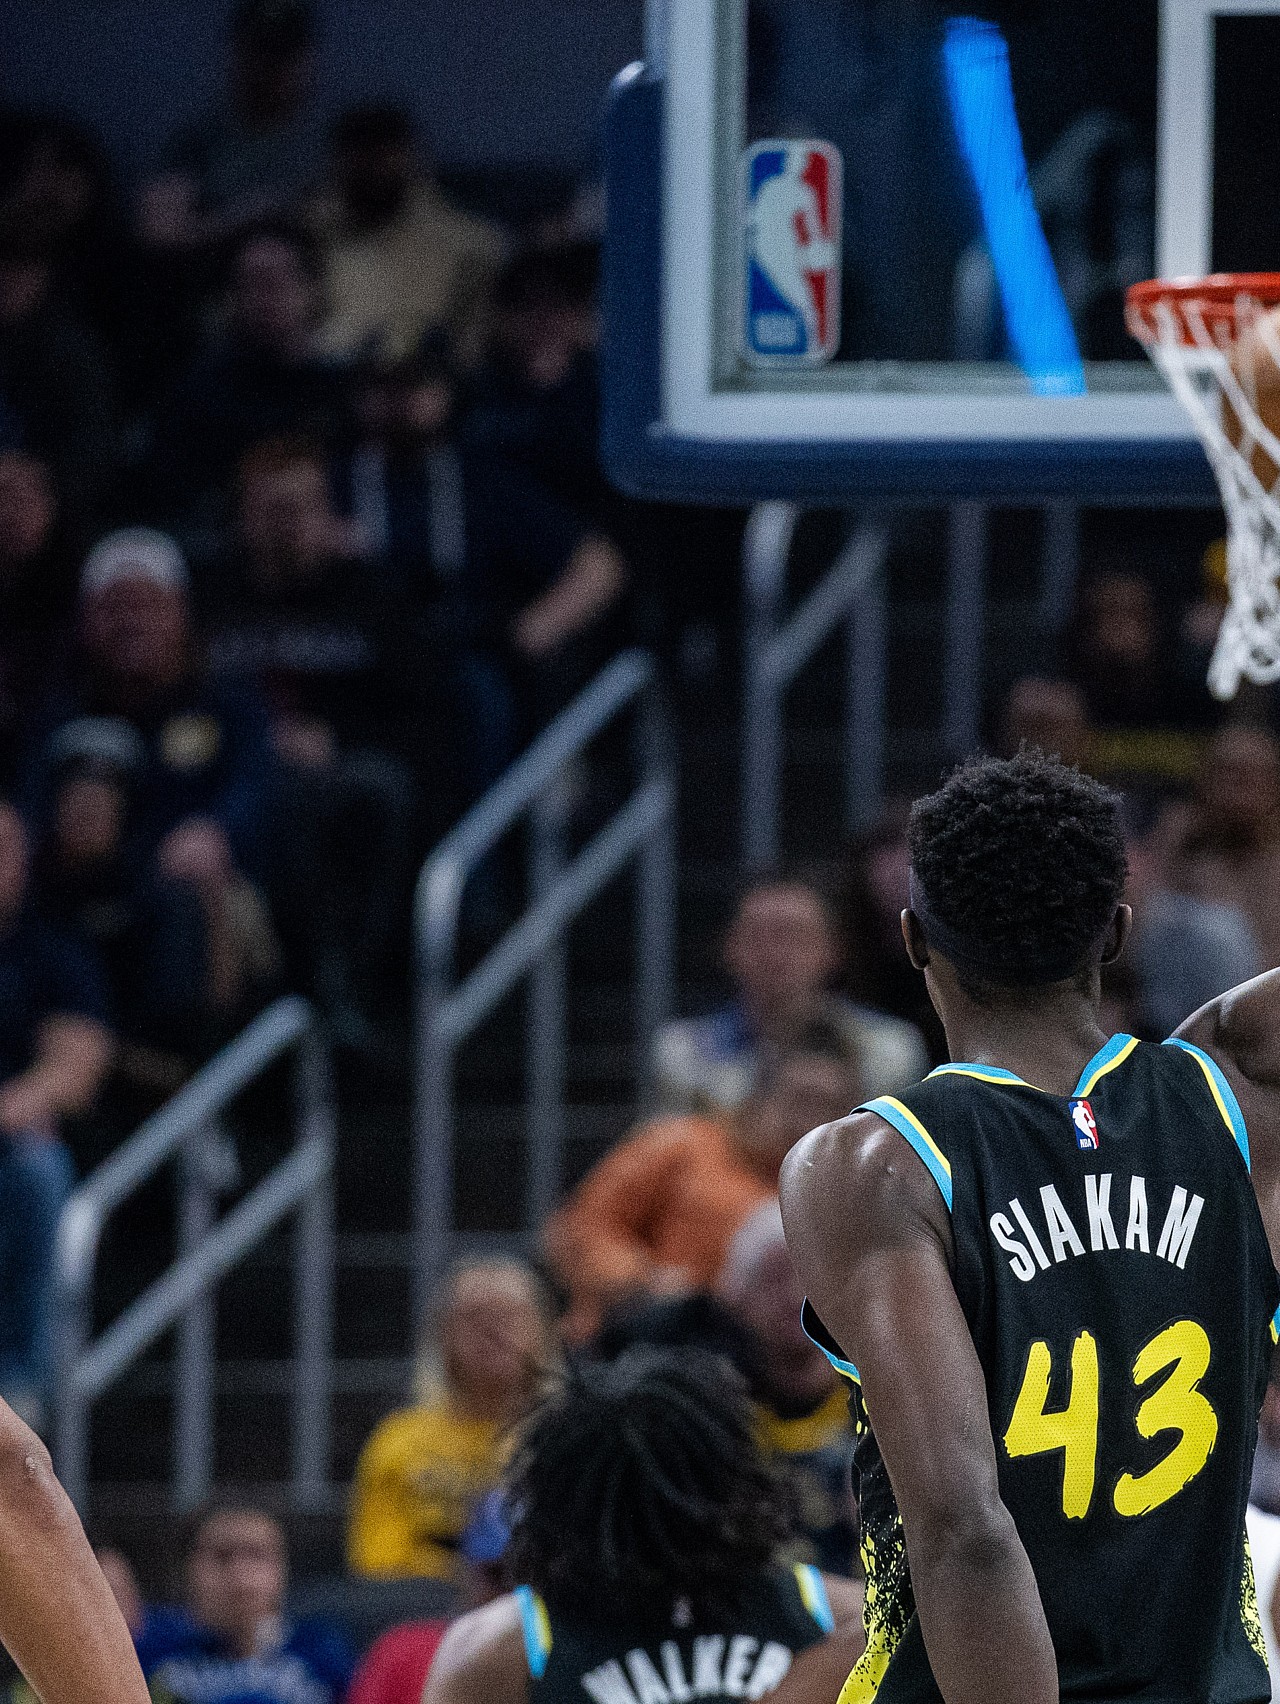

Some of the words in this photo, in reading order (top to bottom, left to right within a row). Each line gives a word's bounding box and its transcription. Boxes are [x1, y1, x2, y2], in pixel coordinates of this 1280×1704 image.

[1079, 1138, 1092, 1148] NBA
[990, 1173, 1205, 1282] SIAKAM
[1003, 1319, 1219, 1519] 43
[580, 1634, 793, 1704] WALKER
